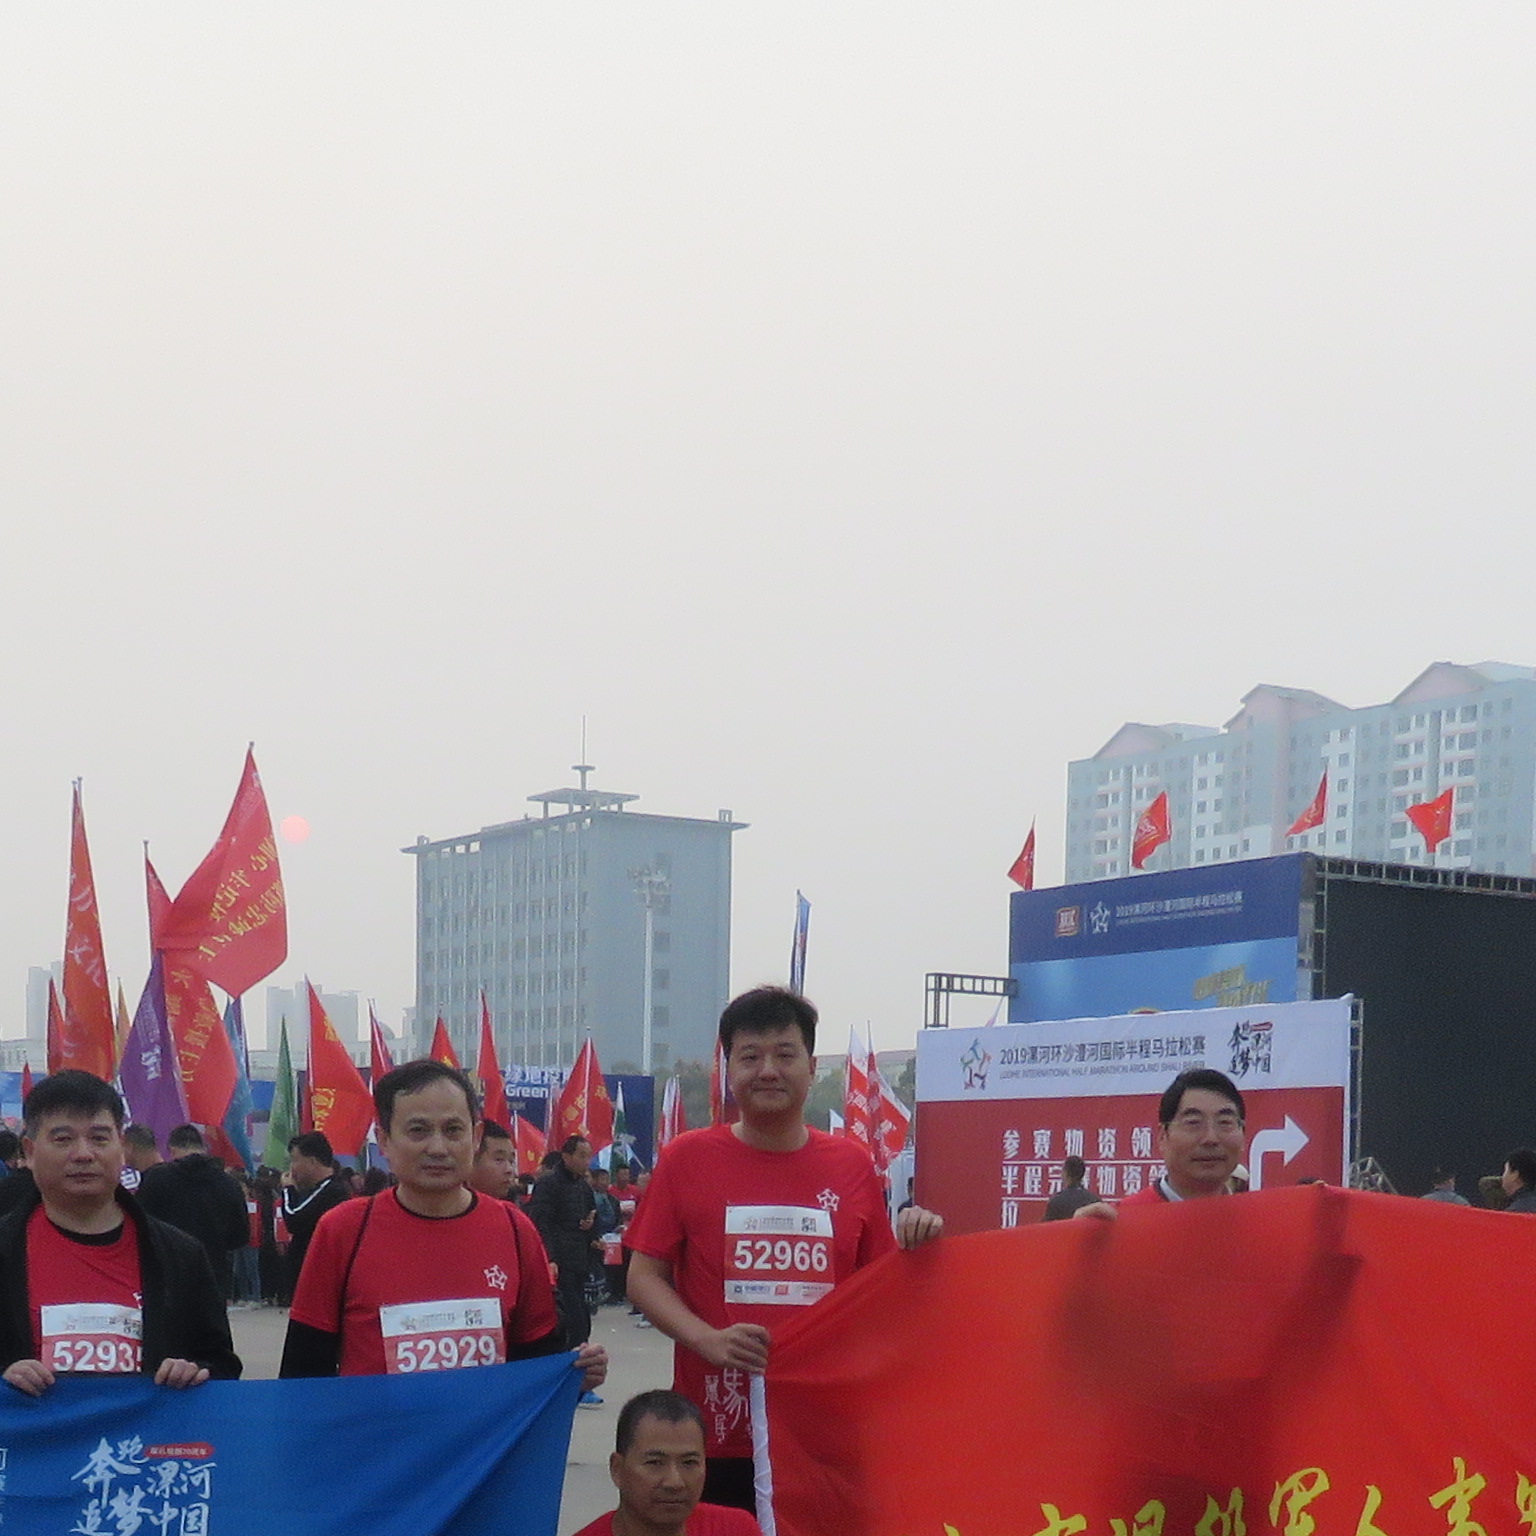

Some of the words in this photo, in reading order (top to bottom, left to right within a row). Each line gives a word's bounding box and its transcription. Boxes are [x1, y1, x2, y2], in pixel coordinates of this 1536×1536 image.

[1000, 1035, 1206, 1065] 2019漯河环沙澧河国际半程马拉松赛
[1022, 1067, 1070, 1078] INTERNATIONAL
[1071, 1066, 1088, 1076] HALF
[1090, 1063, 1129, 1075] MARATHON
[1130, 1062, 1160, 1074] AROUND
[505, 1083, 549, 1098] Green
[734, 1239, 828, 1272] 52966
[396, 1335, 497, 1373] 52929
[71, 1435, 217, 1508] 奔跑漯河
